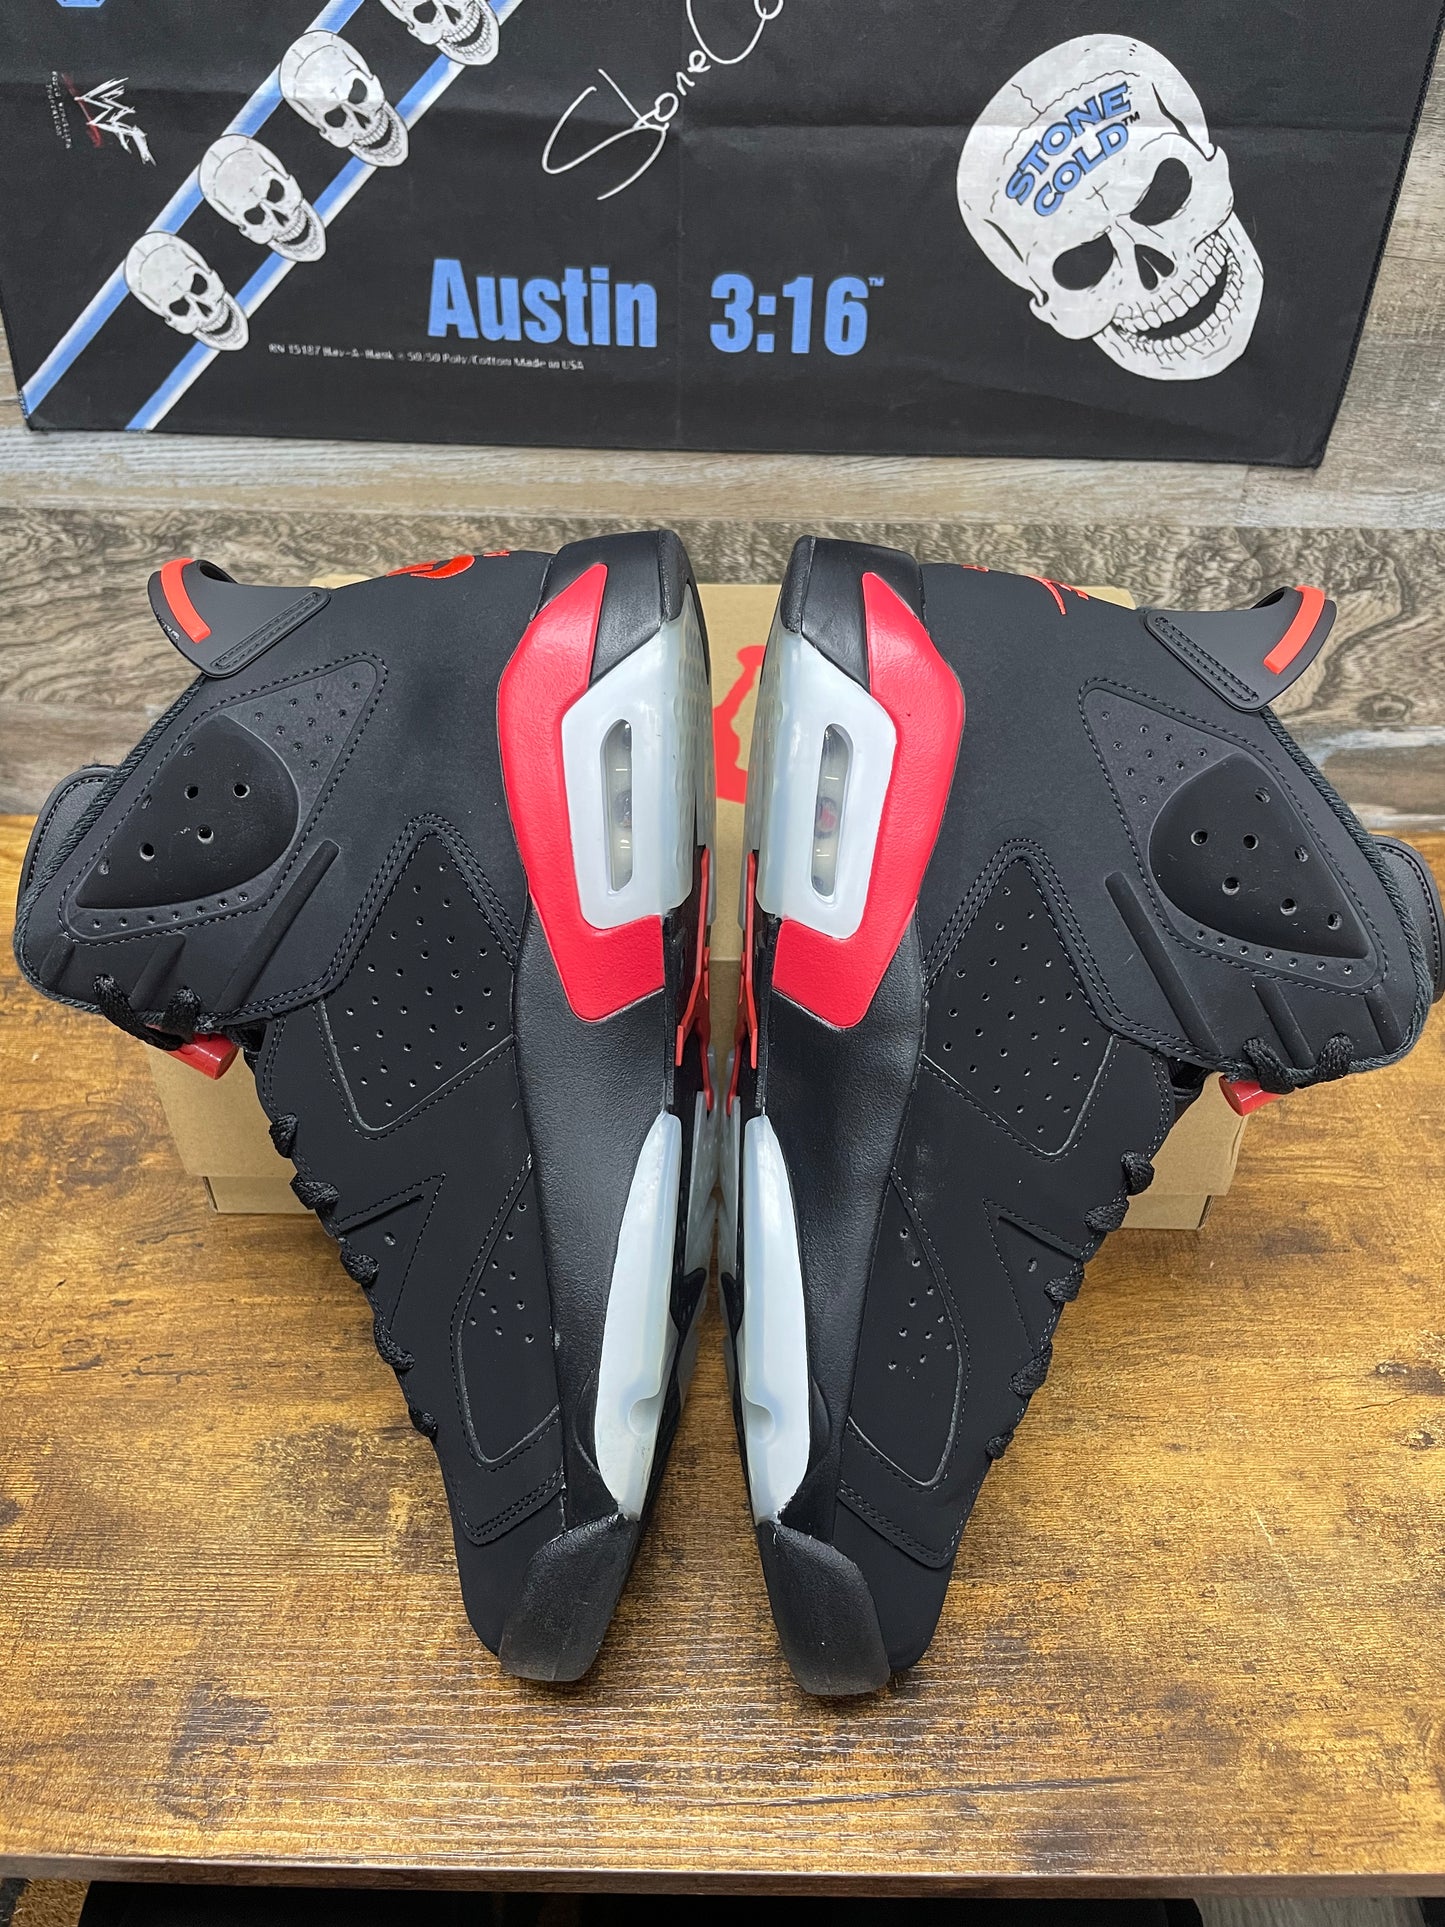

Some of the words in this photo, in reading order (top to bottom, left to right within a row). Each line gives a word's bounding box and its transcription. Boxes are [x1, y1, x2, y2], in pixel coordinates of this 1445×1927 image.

[1005, 81, 1132, 206] STONE
[1034, 122, 1129, 217] COLD
[427, 258, 658, 348] Austin
[710, 272, 870, 356] 3:16
[513, 358, 546, 369] Made
[548, 361, 560, 370] in
[561, 360, 585, 371] USA
